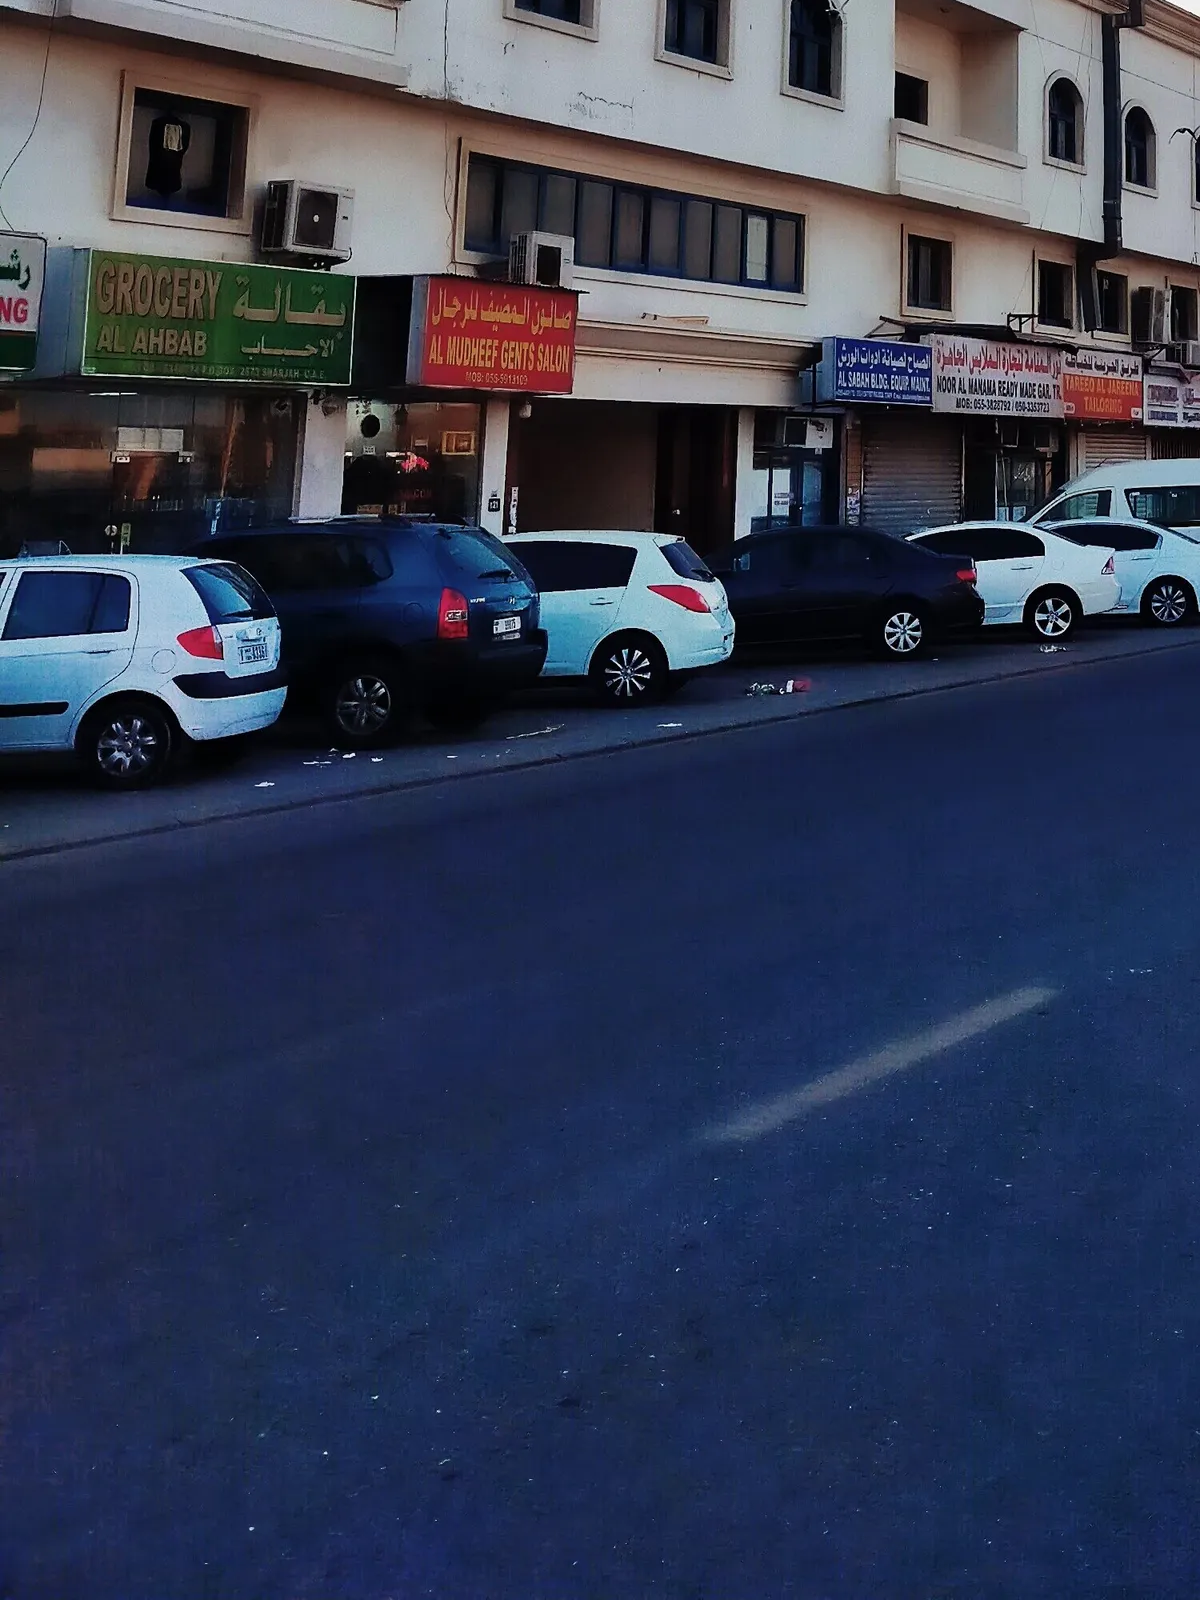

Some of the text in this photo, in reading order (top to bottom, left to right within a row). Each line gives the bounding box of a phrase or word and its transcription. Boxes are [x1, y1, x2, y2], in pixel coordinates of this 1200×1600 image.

[96, 259, 223, 320] GROCERY
[233, 275, 347, 327] بقالة
[432, 287, 572, 335] صالون المضيف للرجال
[96, 324, 208, 357] AL AHBAB
[429, 334, 570, 373] AL MUDHEEF GENTS SALON
[838, 371, 847, 387] AL
[848, 371, 870, 388] SABAH
[936, 375, 957, 394] NOOR
[957, 376, 967, 395] AL
[968, 377, 997, 397] MANAMA
[997, 379, 1019, 398] READY
[1019, 381, 1037, 399] MADE
[1096, 378, 1105, 394] AL
[956, 398, 973, 409] MOB:
